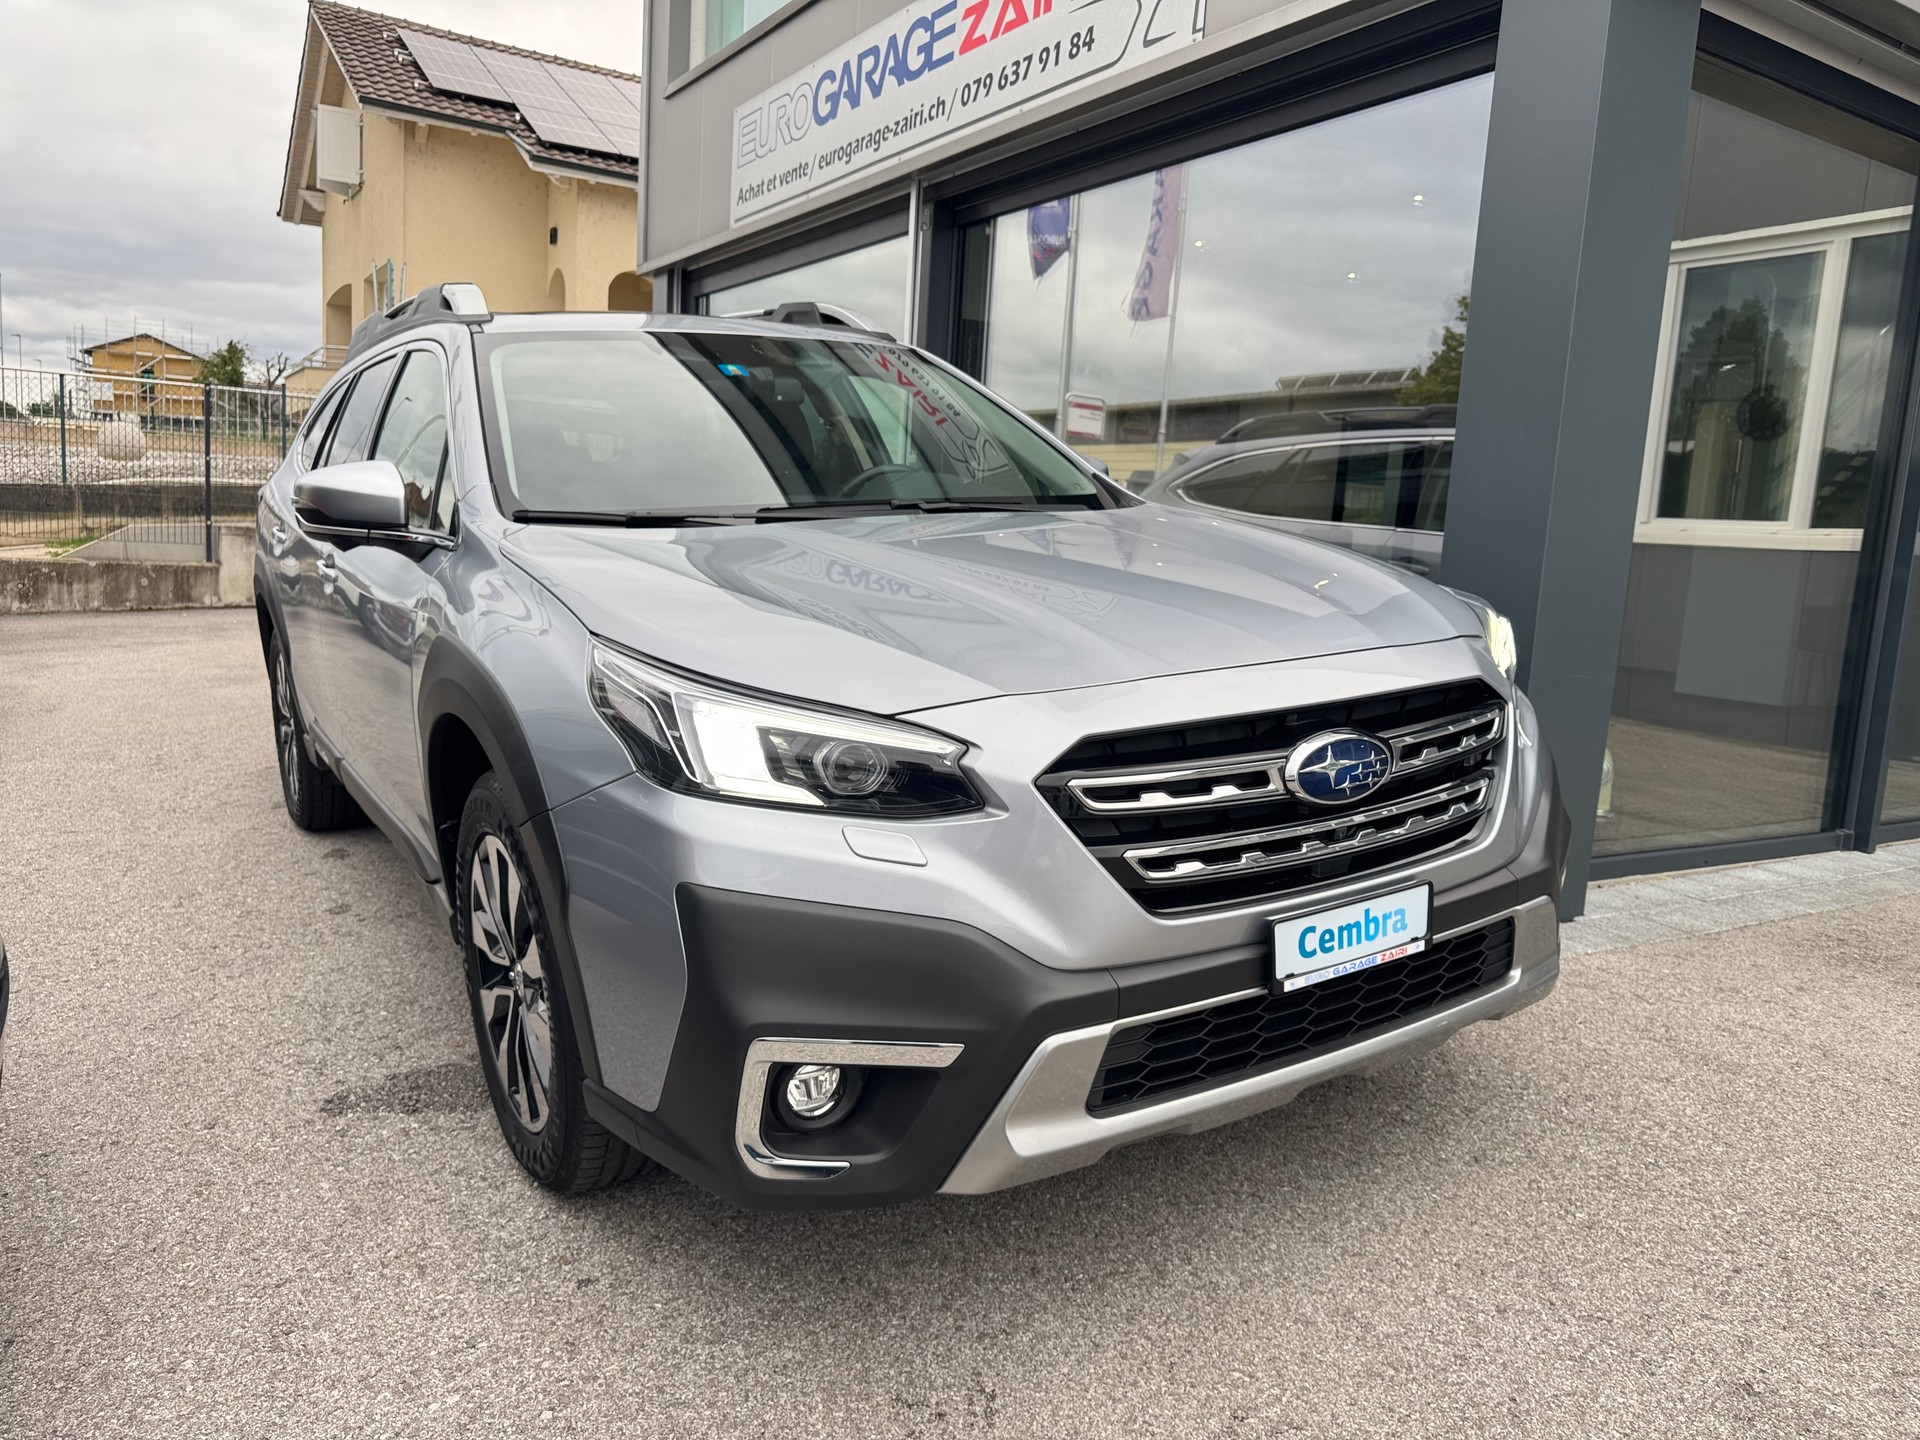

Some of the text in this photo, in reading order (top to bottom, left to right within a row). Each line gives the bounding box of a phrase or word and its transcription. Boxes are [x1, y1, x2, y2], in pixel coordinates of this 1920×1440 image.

[736, 179, 765, 207] Achat
[766, 174, 777, 193] et
[779, 161, 809, 188] vente
[818, 96, 946, 171] eurogarage-zairi.ch
[960, 72, 994, 107] 079
[997, 53, 1034, 91] 637
[1038, 40, 1062, 74] 91
[1068, 24, 1096, 60] 84
[1298, 907, 1408, 959] Cembra
[1304, 947, 1408, 985] EURO GARAGE ZAIRI
